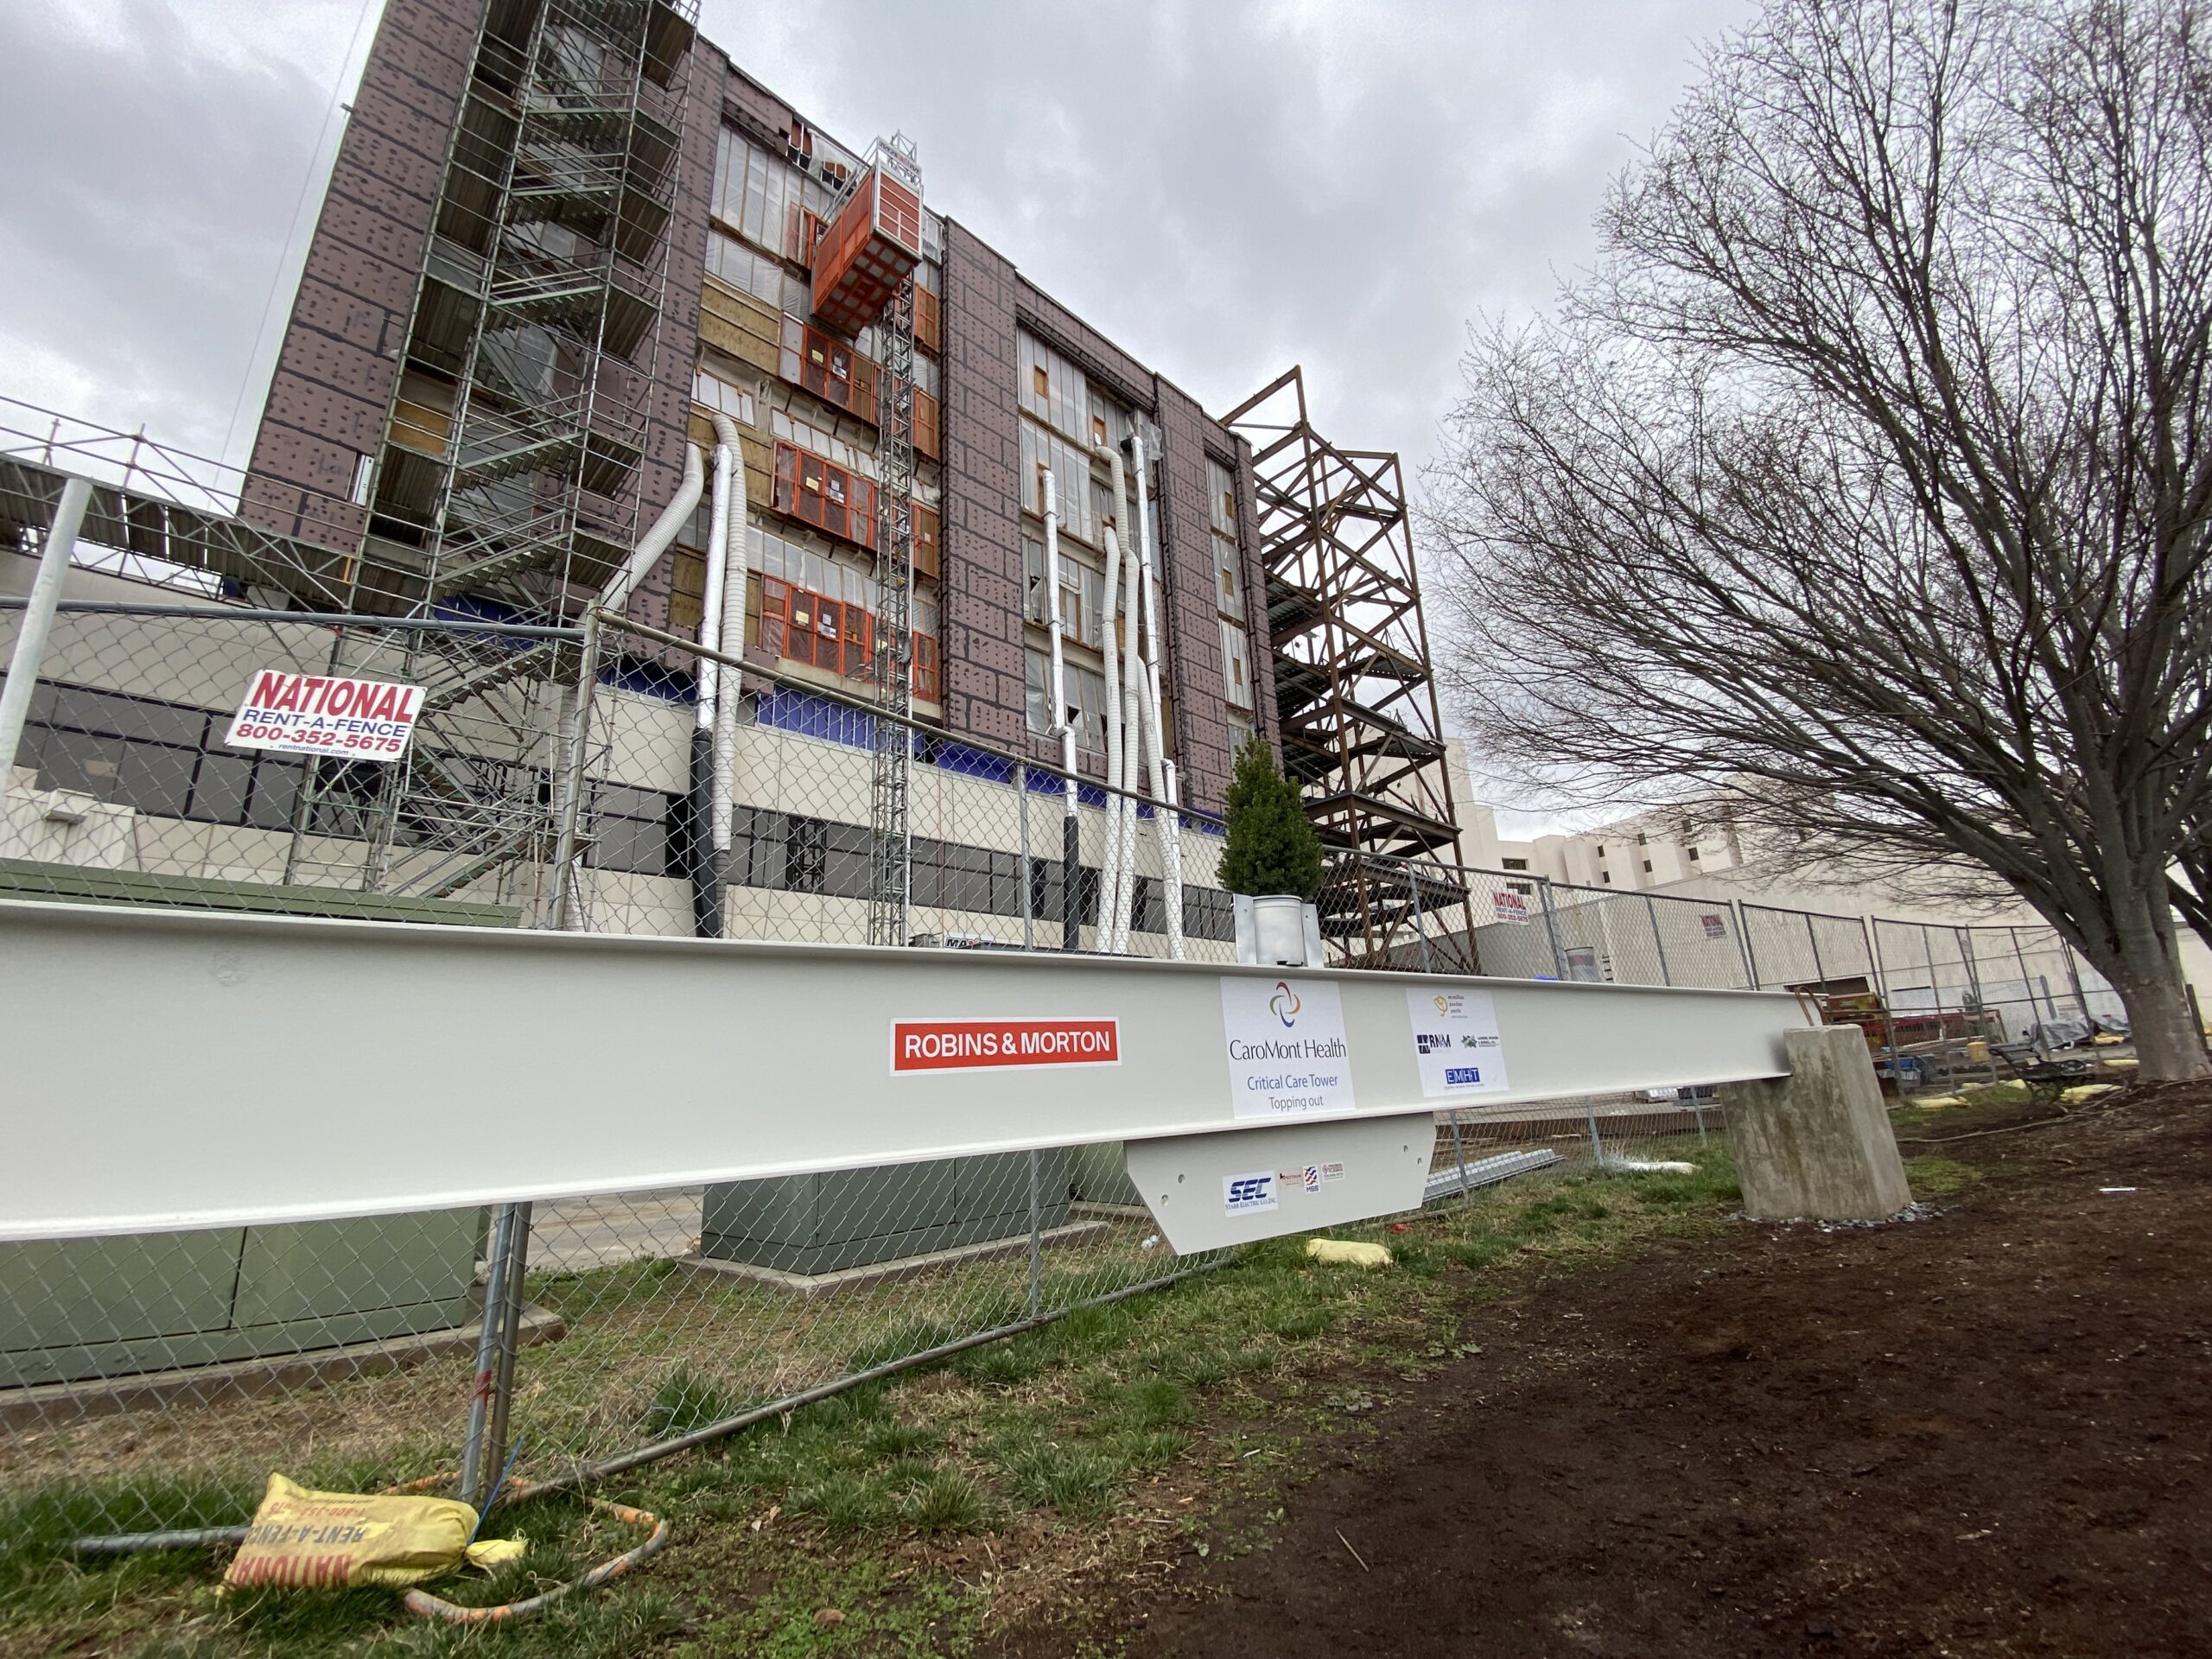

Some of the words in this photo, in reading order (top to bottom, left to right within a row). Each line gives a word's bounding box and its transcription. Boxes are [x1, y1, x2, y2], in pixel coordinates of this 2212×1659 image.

[251, 672, 414, 723] NATIONAL
[243, 709, 409, 737] RENT-A-FENCE
[237, 724, 402, 752] 800-352-5675
[278, 744, 349, 755] rentnational.com
[1493, 892, 1526, 910] NATIONAL
[905, 1033, 997, 1058] ROBINS
[1001, 1033, 1018, 1054] &
[1021, 1031, 1110, 1053] MORTON
[1230, 1039, 1302, 1060] CaroMont
[1305, 1038, 1347, 1058] Health
[1248, 1075, 1283, 1090] Critical
[1286, 1075, 1308, 1089] Care
[1309, 1074, 1338, 1087] Tower
[1268, 1096, 1306, 1111] Topping
[1308, 1095, 1324, 1106] out
[1229, 1177, 1271, 1203] SEC
